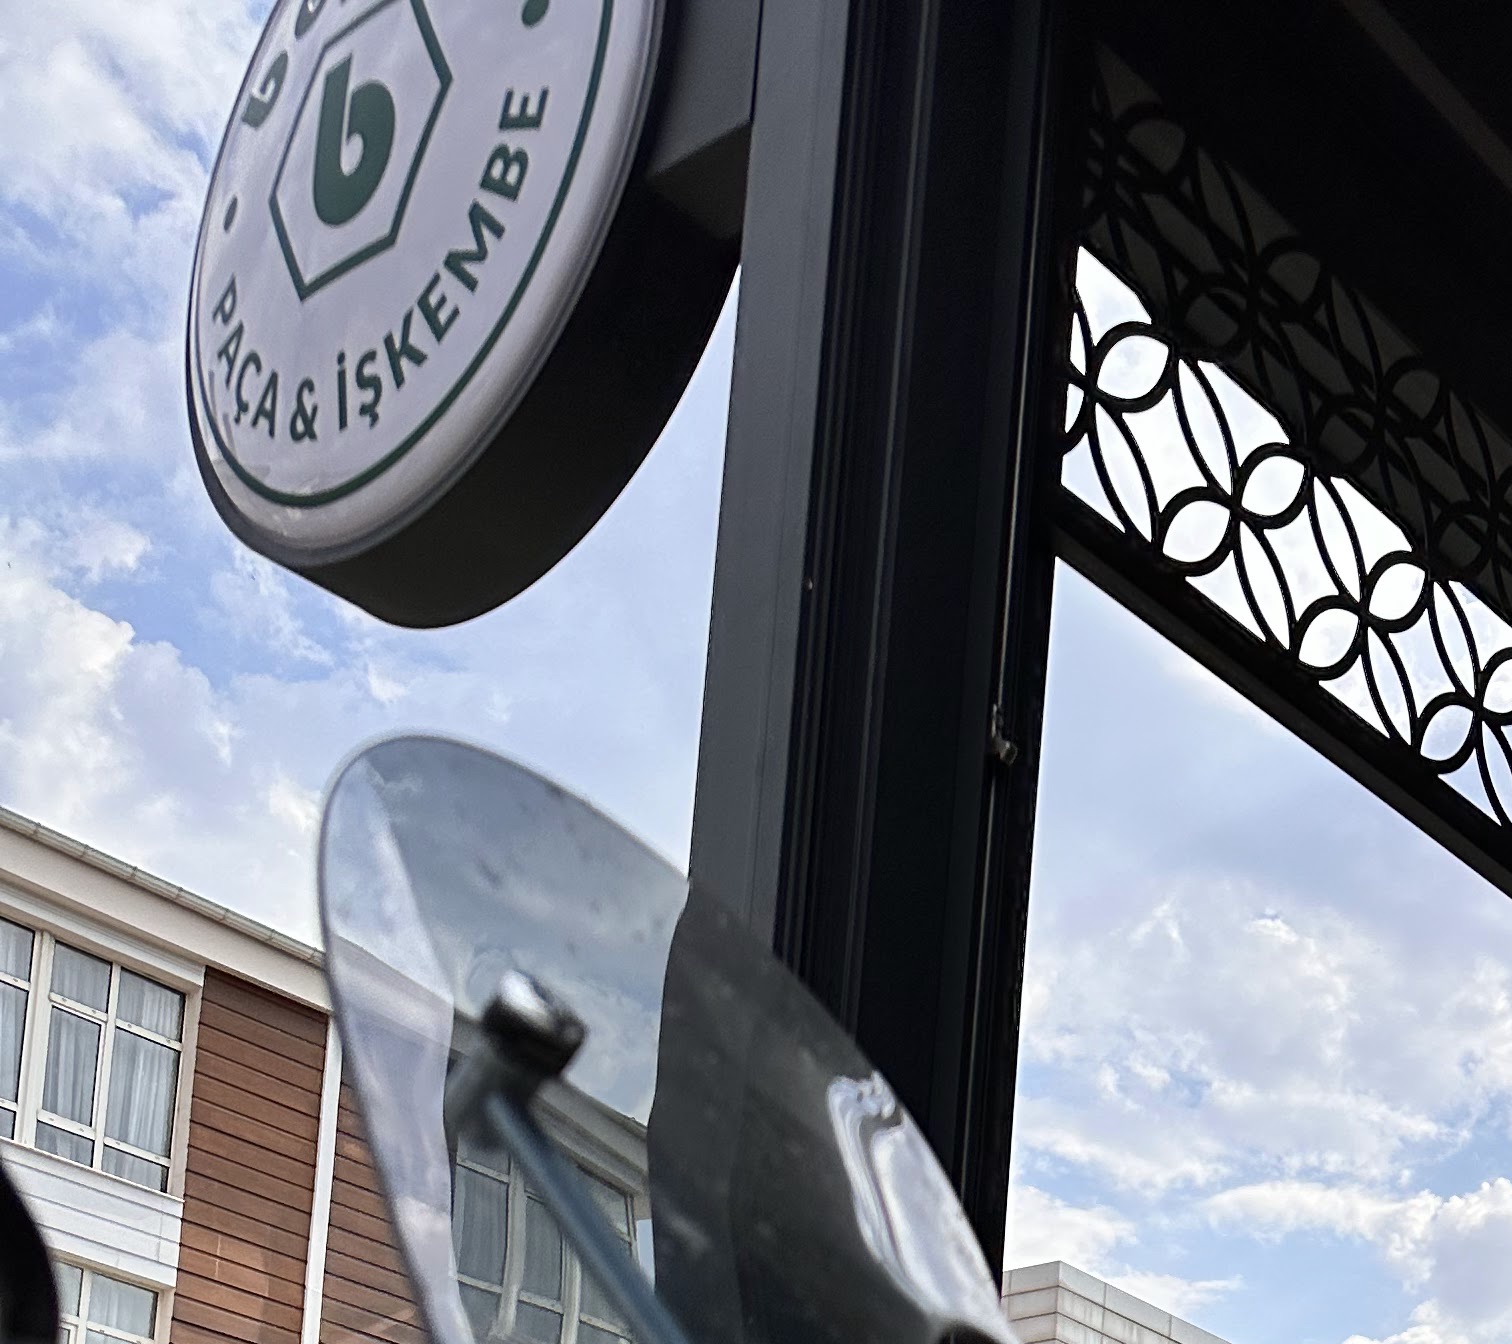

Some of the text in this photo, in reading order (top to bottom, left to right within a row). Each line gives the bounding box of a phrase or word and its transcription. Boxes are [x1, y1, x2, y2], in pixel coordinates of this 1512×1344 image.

[210, 85, 550, 442] PAÇA & İŞKEMBE
